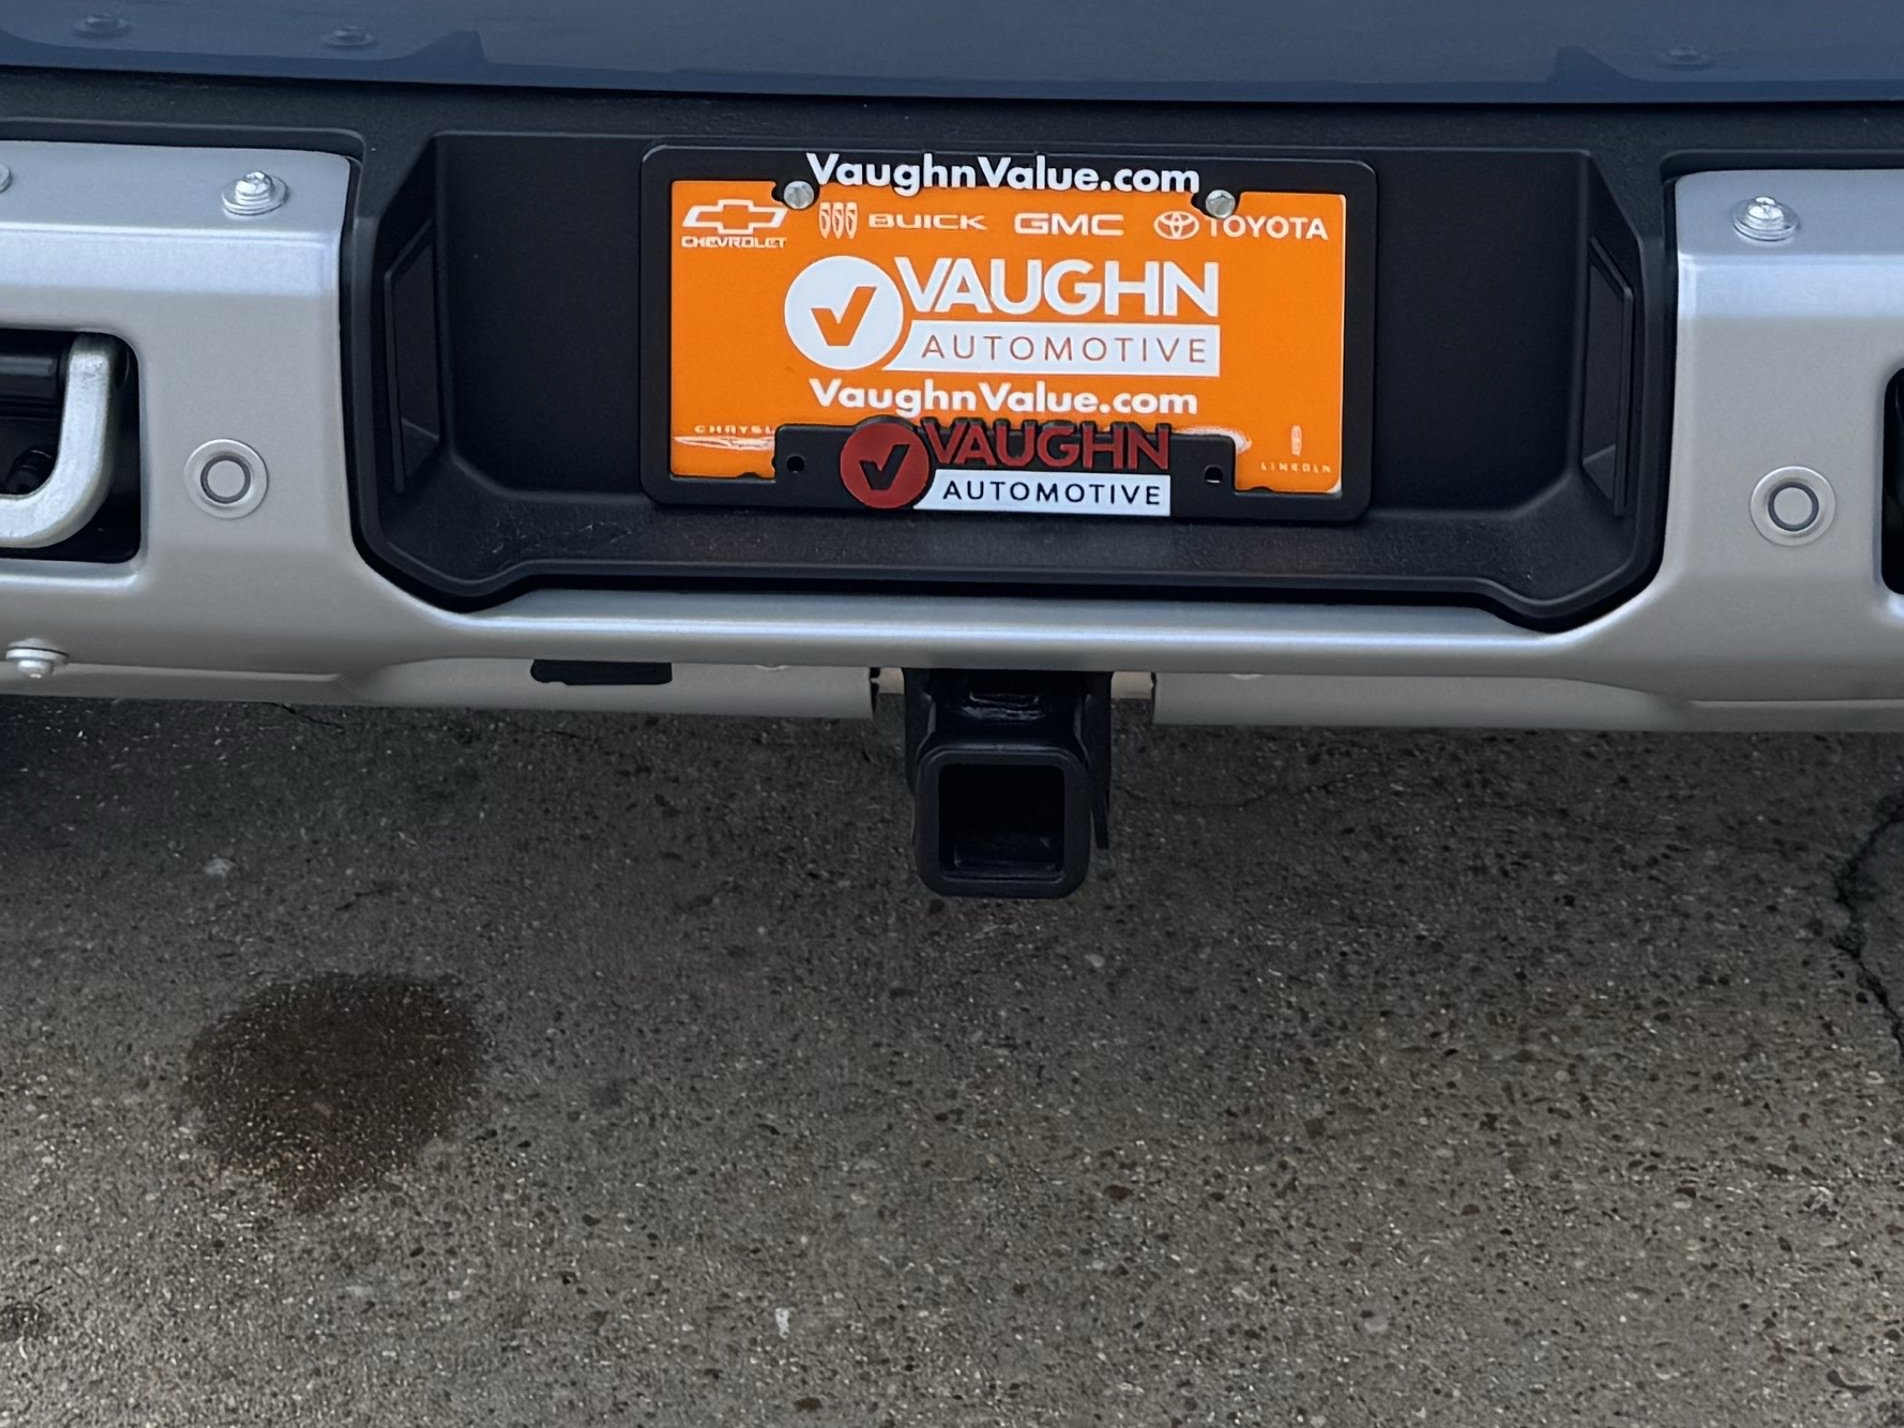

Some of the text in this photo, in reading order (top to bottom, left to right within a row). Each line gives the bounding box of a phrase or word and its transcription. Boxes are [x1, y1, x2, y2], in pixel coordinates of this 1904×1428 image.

[806, 152, 1200, 197] VaughnValue.com
[868, 213, 988, 230] BUICK
[1014, 213, 1124, 236] GMC
[1205, 215, 1329, 241] TOYOTA
[681, 236, 788, 249] CHEVROLET
[894, 256, 1219, 318] VAUGHN
[922, 334, 1207, 363] AUTOMOTIVE
[809, 377, 1197, 419] VaughnValue.com
[923, 420, 1171, 470] VAUGHN
[943, 480, 1161, 506] AUTOMOTIVE
